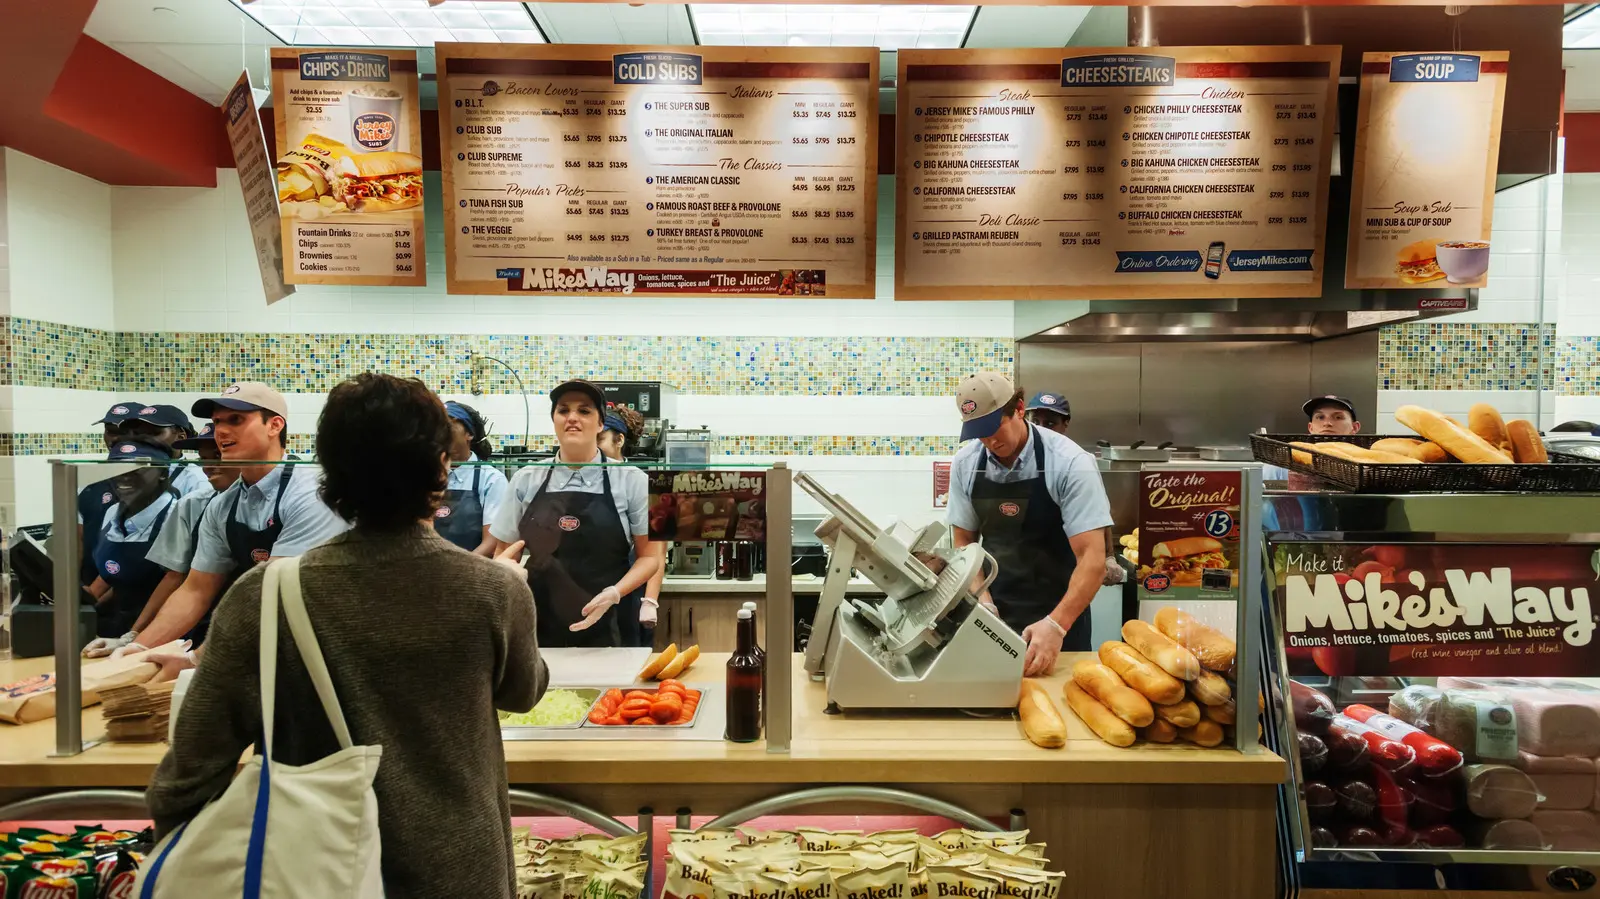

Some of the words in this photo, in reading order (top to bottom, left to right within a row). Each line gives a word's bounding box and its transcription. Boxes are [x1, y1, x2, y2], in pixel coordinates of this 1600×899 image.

[303, 62, 340, 77] CHIPS
[348, 62, 386, 78] DRINK
[619, 63, 656, 80] COLD
[659, 64, 698, 81] SUBS
[1066, 66, 1170, 83] CHEESESTEAKS
[1415, 63, 1455, 79] SOUP
[505, 82, 540, 95] Bacon
[544, 82, 580, 96] Lovers
[730, 85, 774, 99] Italians
[1201, 86, 1244, 99] Chicken
[999, 89, 1030, 101] Steak
[670, 102, 693, 110] SUPER
[925, 107, 951, 115] JERSEY
[953, 107, 977, 115] MIKE'S
[979, 107, 1009, 115] FAMOUS
[1011, 107, 1035, 115] PHILLY
[1134, 105, 1165, 114] CHICKEN
[1167, 105, 1190, 114] PHILLY
[1192, 104, 1242, 113] CHEESESTEAK
[467, 126, 485, 134] CLUB
[487, 126, 502, 134] SUB
[655, 129, 668, 137] THE
[670, 129, 704, 137] ORIGINAL
[960, 134, 1009, 142] CHEESESTEAK
[1133, 132, 1163, 141] CHICKEN
[1165, 132, 1199, 140] CHIPOTLE
[1201, 131, 1250, 140] CHEESESTEAK
[488, 153, 522, 161] SUPREME
[719, 158, 742, 171] The
[743, 158, 782, 171] Classics
[924, 160, 936, 169] BIG
[938, 161, 968, 169] KAHUNA
[970, 160, 1019, 168] CHEESESTEAK
[1131, 158, 1143, 167] BIG
[1145, 158, 1176, 167] KAHUNA
[1177, 158, 1208, 167] CHICKEN
[1210, 158, 1259, 166] CHEESESTEAK
[670, 176, 709, 184] AMERICAN
[710, 176, 740, 185] CLASSIC
[506, 183, 550, 196] Popular
[556, 184, 585, 196] Picks
[923, 187, 965, 195] CALIFORNIA
[966, 187, 1015, 195] CHEESESTEAK
[1129, 185, 1171, 194] CALIFORNIA
[1173, 185, 1204, 193] CHICKEN
[1205, 184, 1254, 193] CHEESESTEAK
[469, 199, 489, 208] TUNA
[491, 200, 507, 208] FISH
[688, 203, 711, 211] ROAST
[713, 203, 730, 211] BEEF
[738, 203, 781, 212] PROVOLONE
[1394, 201, 1420, 214] Soup
[1431, 200, 1451, 214] Sub
[979, 214, 1002, 226] Deli
[1005, 214, 1040, 226] Classic
[1128, 211, 1159, 220] BUFFALO
[1161, 211, 1192, 220] CHICKEN
[1193, 211, 1242, 219] CHEESESTEAK
[1366, 218, 1383, 226] MINI
[1384, 218, 1399, 226] SUB
[1400, 218, 1406, 226] &
[1407, 218, 1421, 226] CUP
[1423, 218, 1431, 226] OF
[1432, 218, 1451, 226] SOUP
[298, 228, 327, 237] Fountain
[329, 229, 351, 237] Drinks
[656, 229, 683, 237] TURKEY
[685, 229, 712, 237] BREAST
[721, 229, 763, 238] PROVOLONE
[923, 232, 950, 240] GRILLED
[991, 232, 1019, 240] REUBEN
[299, 240, 318, 248] Chips
[300, 251, 332, 260] Brownies
[1234, 255, 1307, 266] JerseyMikes.com
[300, 263, 327, 271] Cookies
[1121, 258, 1152, 269] Online
[1156, 256, 1199, 268] Ordering
[1144, 473, 1180, 488] Taste
[1183, 473, 1206, 486] the
[1148, 486, 1235, 511] Original!
[1286, 553, 1327, 573] Make
[1332, 554, 1344, 571] it
[973, 618, 1019, 659] BIZERBA
[1290, 634, 1331, 647] Onions,
[1333, 633, 1377, 646] lettuce,
[1378, 631, 1434, 644] tomatoes,
[1436, 629, 1471, 642] spices
[1474, 628, 1494, 640] and
[1411, 648, 1429, 659] (red
[1454, 648, 1482, 661] vinegar
[1486, 648, 1501, 656] and
[1504, 646, 1522, 656] olive
[1525, 644, 1535, 654] oil
[1538, 643, 1563, 654] blend)
